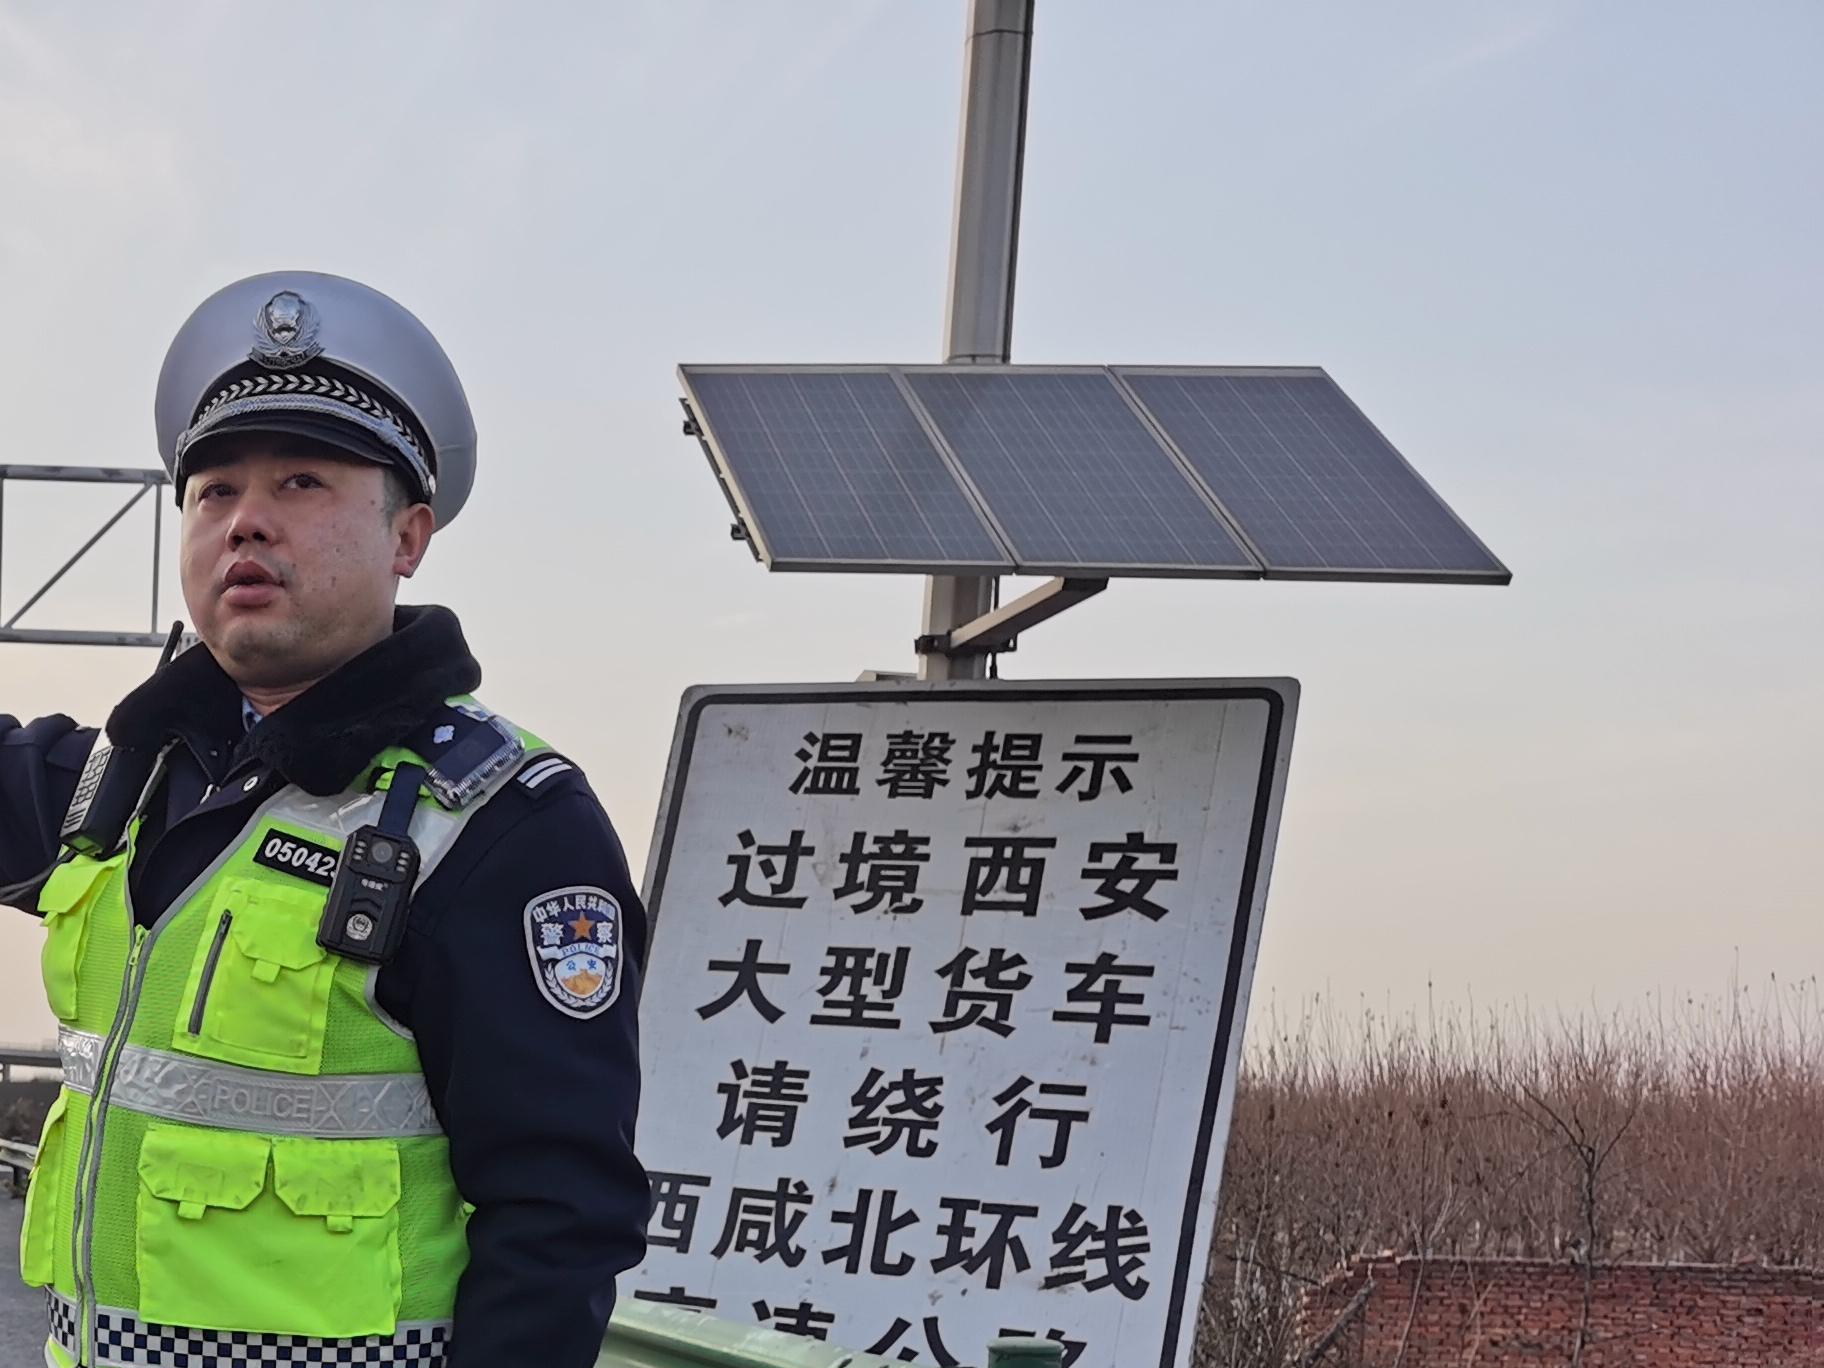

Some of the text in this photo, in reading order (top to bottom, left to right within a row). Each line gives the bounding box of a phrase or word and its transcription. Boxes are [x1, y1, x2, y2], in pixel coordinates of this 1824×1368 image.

[788, 729, 1141, 803] 温馨提示
[263, 836, 340, 882] 05042
[717, 828, 1180, 922] 过境西安
[695, 938, 1156, 1045] 大型货车
[213, 1083, 313, 1119] POLICE
[715, 1058, 1091, 1170] 请绕行
[644, 1168, 1152, 1302] 西咸北环线
